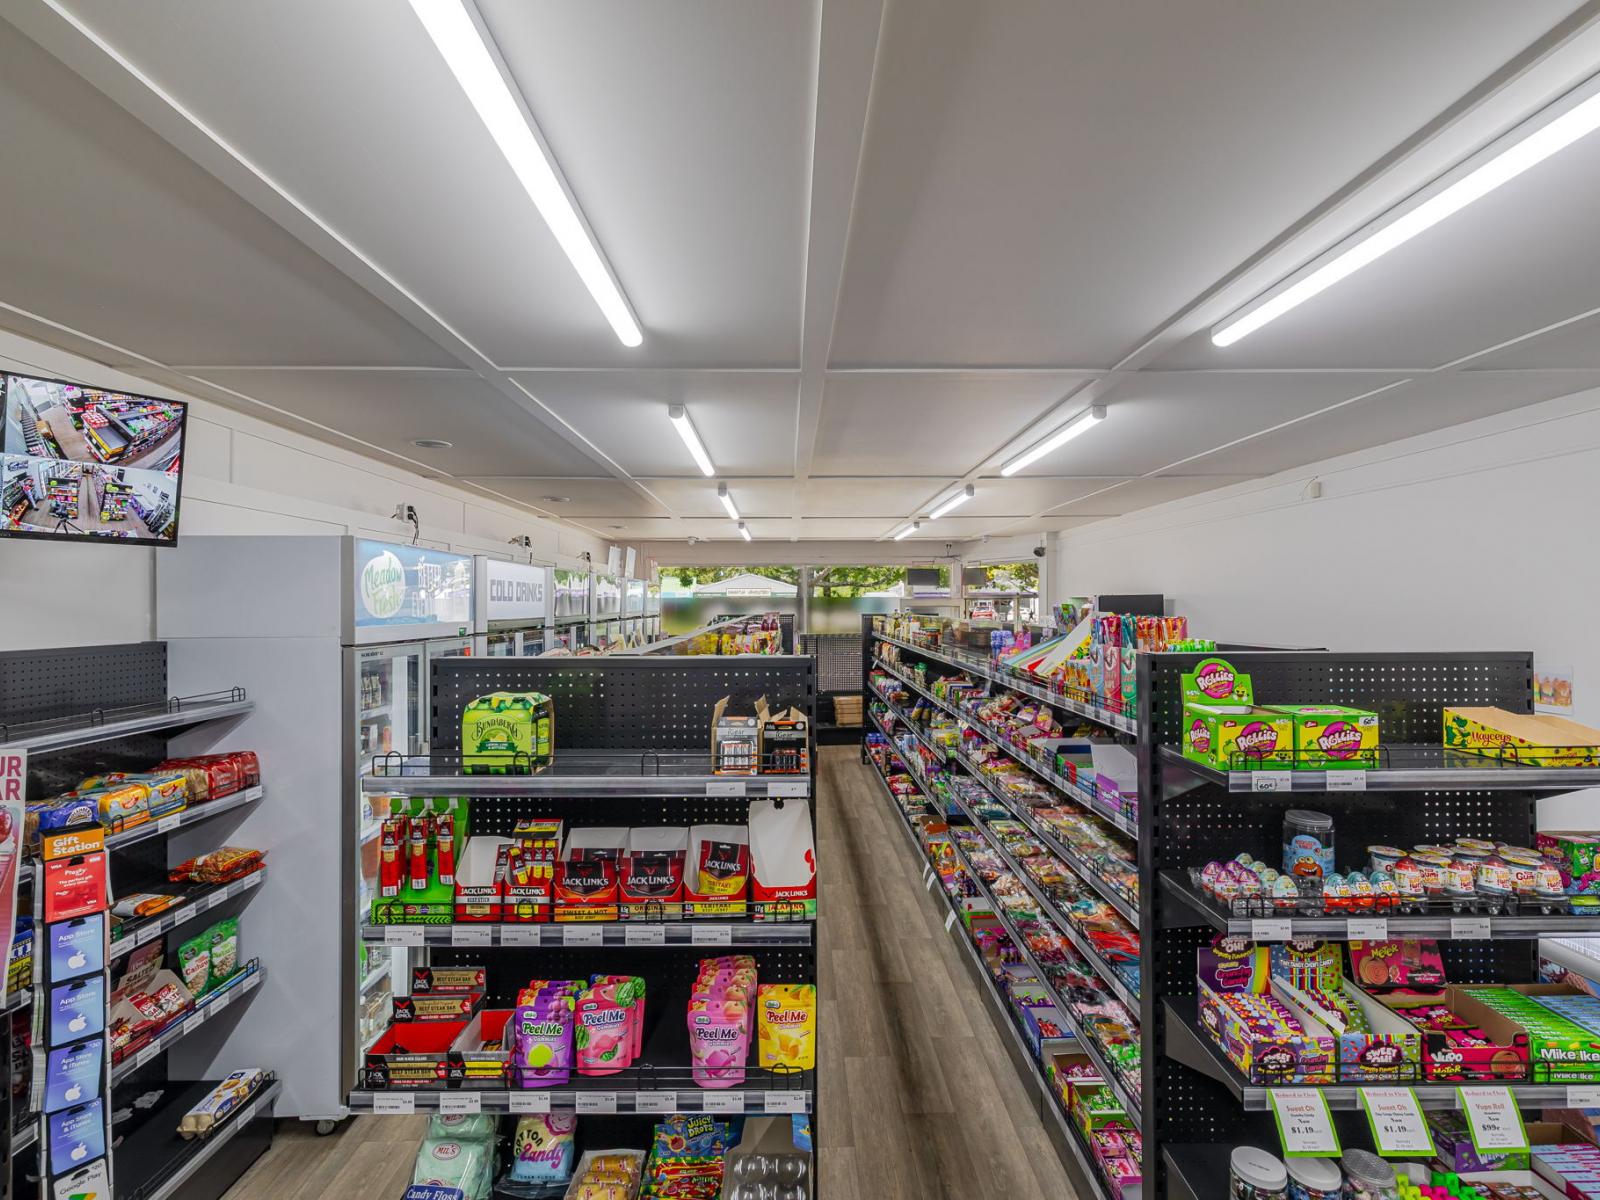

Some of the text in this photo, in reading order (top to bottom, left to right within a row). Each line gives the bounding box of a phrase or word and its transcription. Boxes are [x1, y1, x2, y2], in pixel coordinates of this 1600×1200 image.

[490, 579, 543, 602] COLD DRINKS
[472, 717, 521, 740] BUNDABERG
[0, 779, 20, 800] R
[53, 836, 79, 847] Gift
[53, 841, 100, 856] Station
[704, 860, 720, 869] JACK
[563, 878, 581, 886] JACK
[627, 876, 648, 885] JACK
[58, 934, 74, 942] App
[60, 997, 75, 1006] App
[583, 1010, 626, 1026] Peel Me
[767, 1010, 808, 1022] Peel Me
[522, 1022, 563, 1035] Peel Me
[696, 1028, 738, 1040] Peel Me
[1366, 1047, 1398, 1060] SWEET
[1541, 1048, 1600, 1062] Mike Ike
[60, 1056, 75, 1065] App
[61, 1119, 75, 1128] App
[1384, 1125, 1407, 1133] $1.19
[688, 1124, 713, 1137] DROPS
[1291, 1126, 1314, 1134] $1.19
[519, 1142, 566, 1169] Candy
[60, 1179, 85, 1194] Google
[406, 1188, 458, 1200] Candy Floss
